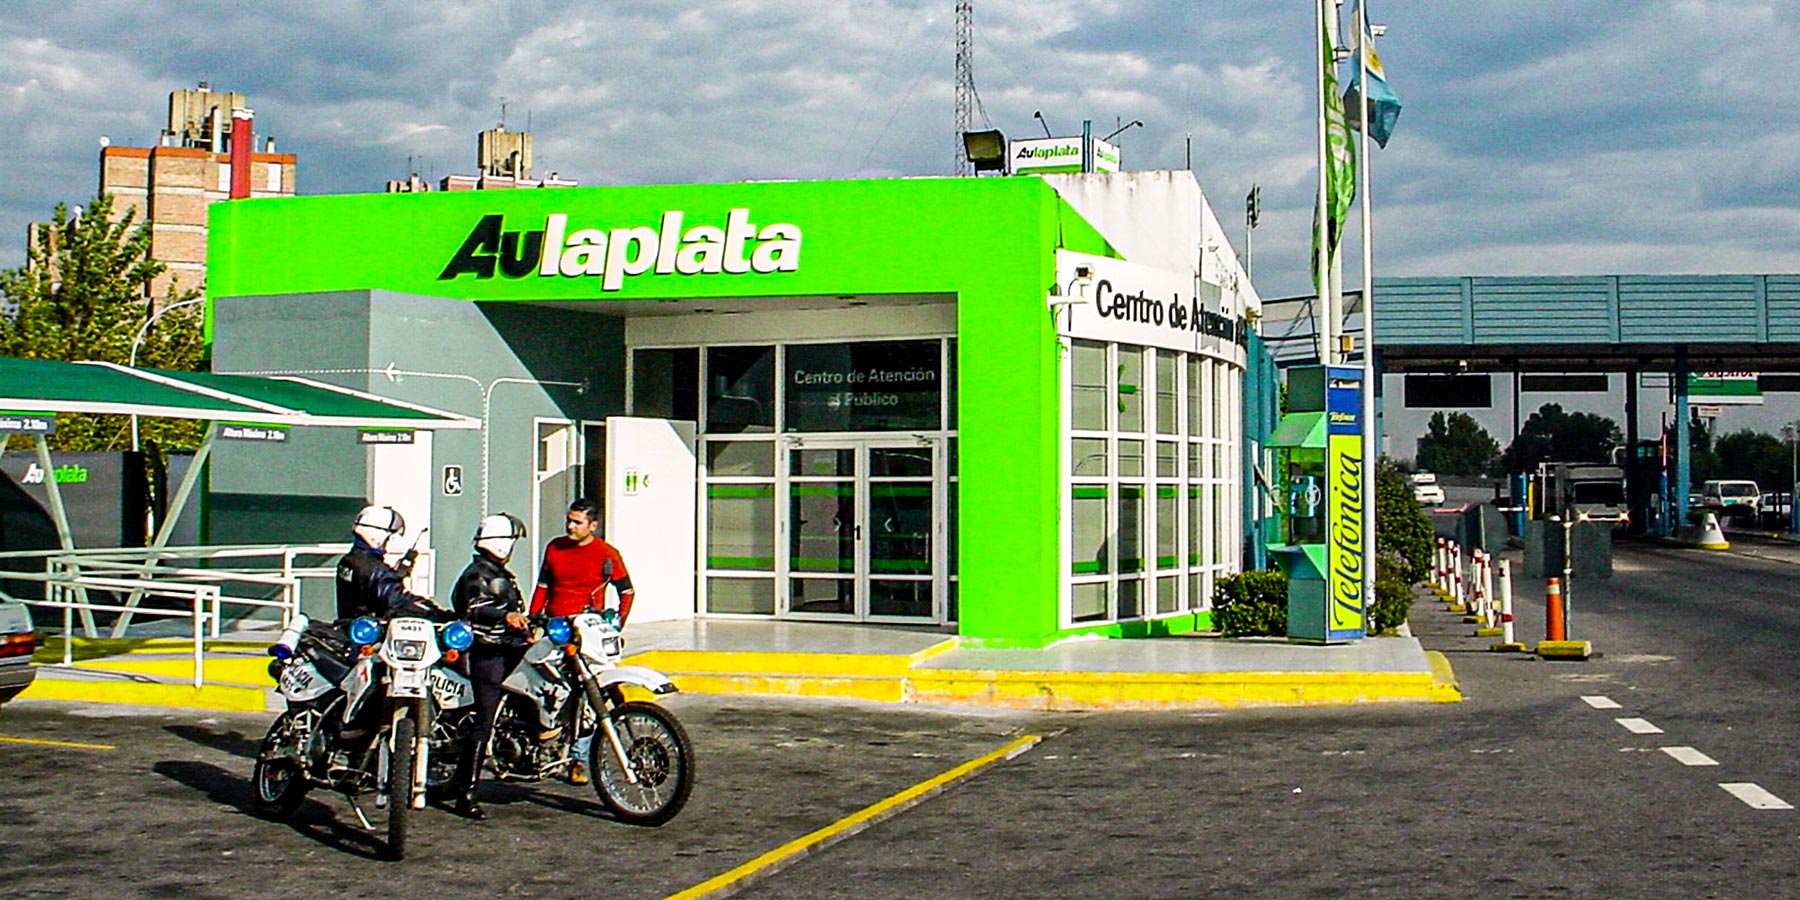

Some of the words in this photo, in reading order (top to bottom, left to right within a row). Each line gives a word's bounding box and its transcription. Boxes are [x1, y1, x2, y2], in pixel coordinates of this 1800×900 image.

[1016, 145, 1079, 160] Aulaplata
[436, 208, 802, 291] Aulaplata
[1096, 279, 1164, 326] Centro
[1169, 293, 1188, 330] de
[794, 370, 843, 384] Centro
[847, 369, 866, 383] de
[868, 367, 936, 383] Atención
